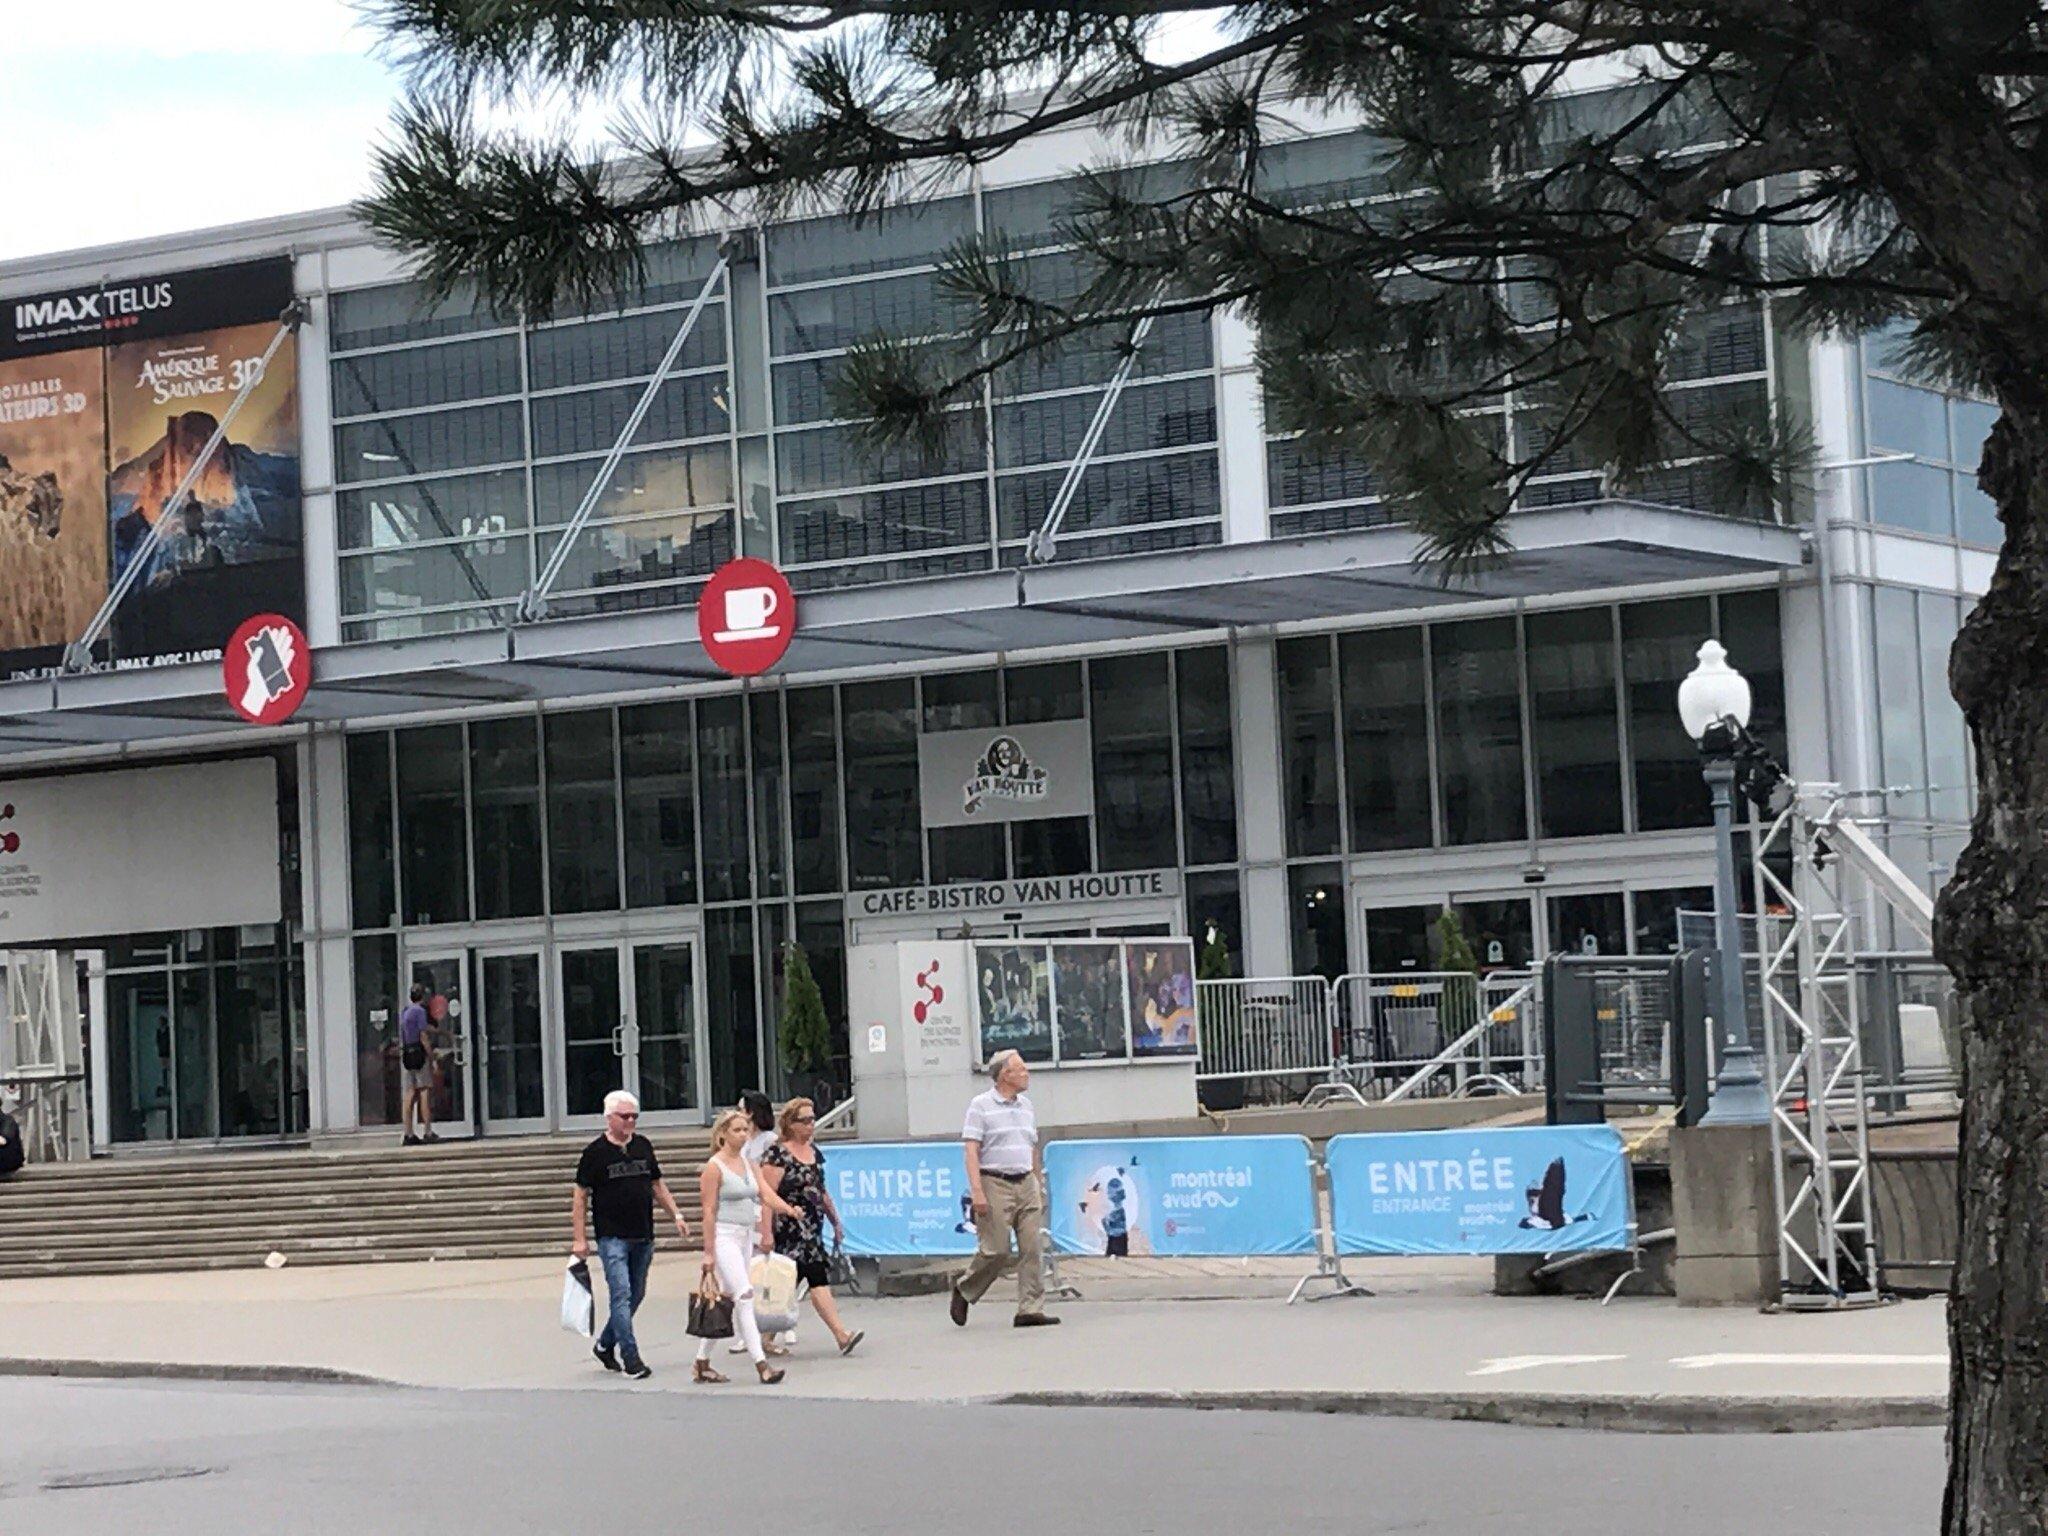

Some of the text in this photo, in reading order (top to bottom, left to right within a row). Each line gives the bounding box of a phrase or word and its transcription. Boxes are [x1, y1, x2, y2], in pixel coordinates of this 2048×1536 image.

[15, 282, 173, 329] IMAX TELUS
[228, 356, 264, 391] 3D
[63, 392, 87, 414] 3D
[863, 872, 1163, 914] CAFÉ-BISTRO VAN HOUTTE
[839, 1160, 953, 1200] ENTRÉE
[1170, 1166, 1252, 1188] montréal
[1368, 1148, 1515, 1194] ENTRÉE
[1372, 1197, 1451, 1214] ENTRANCE
